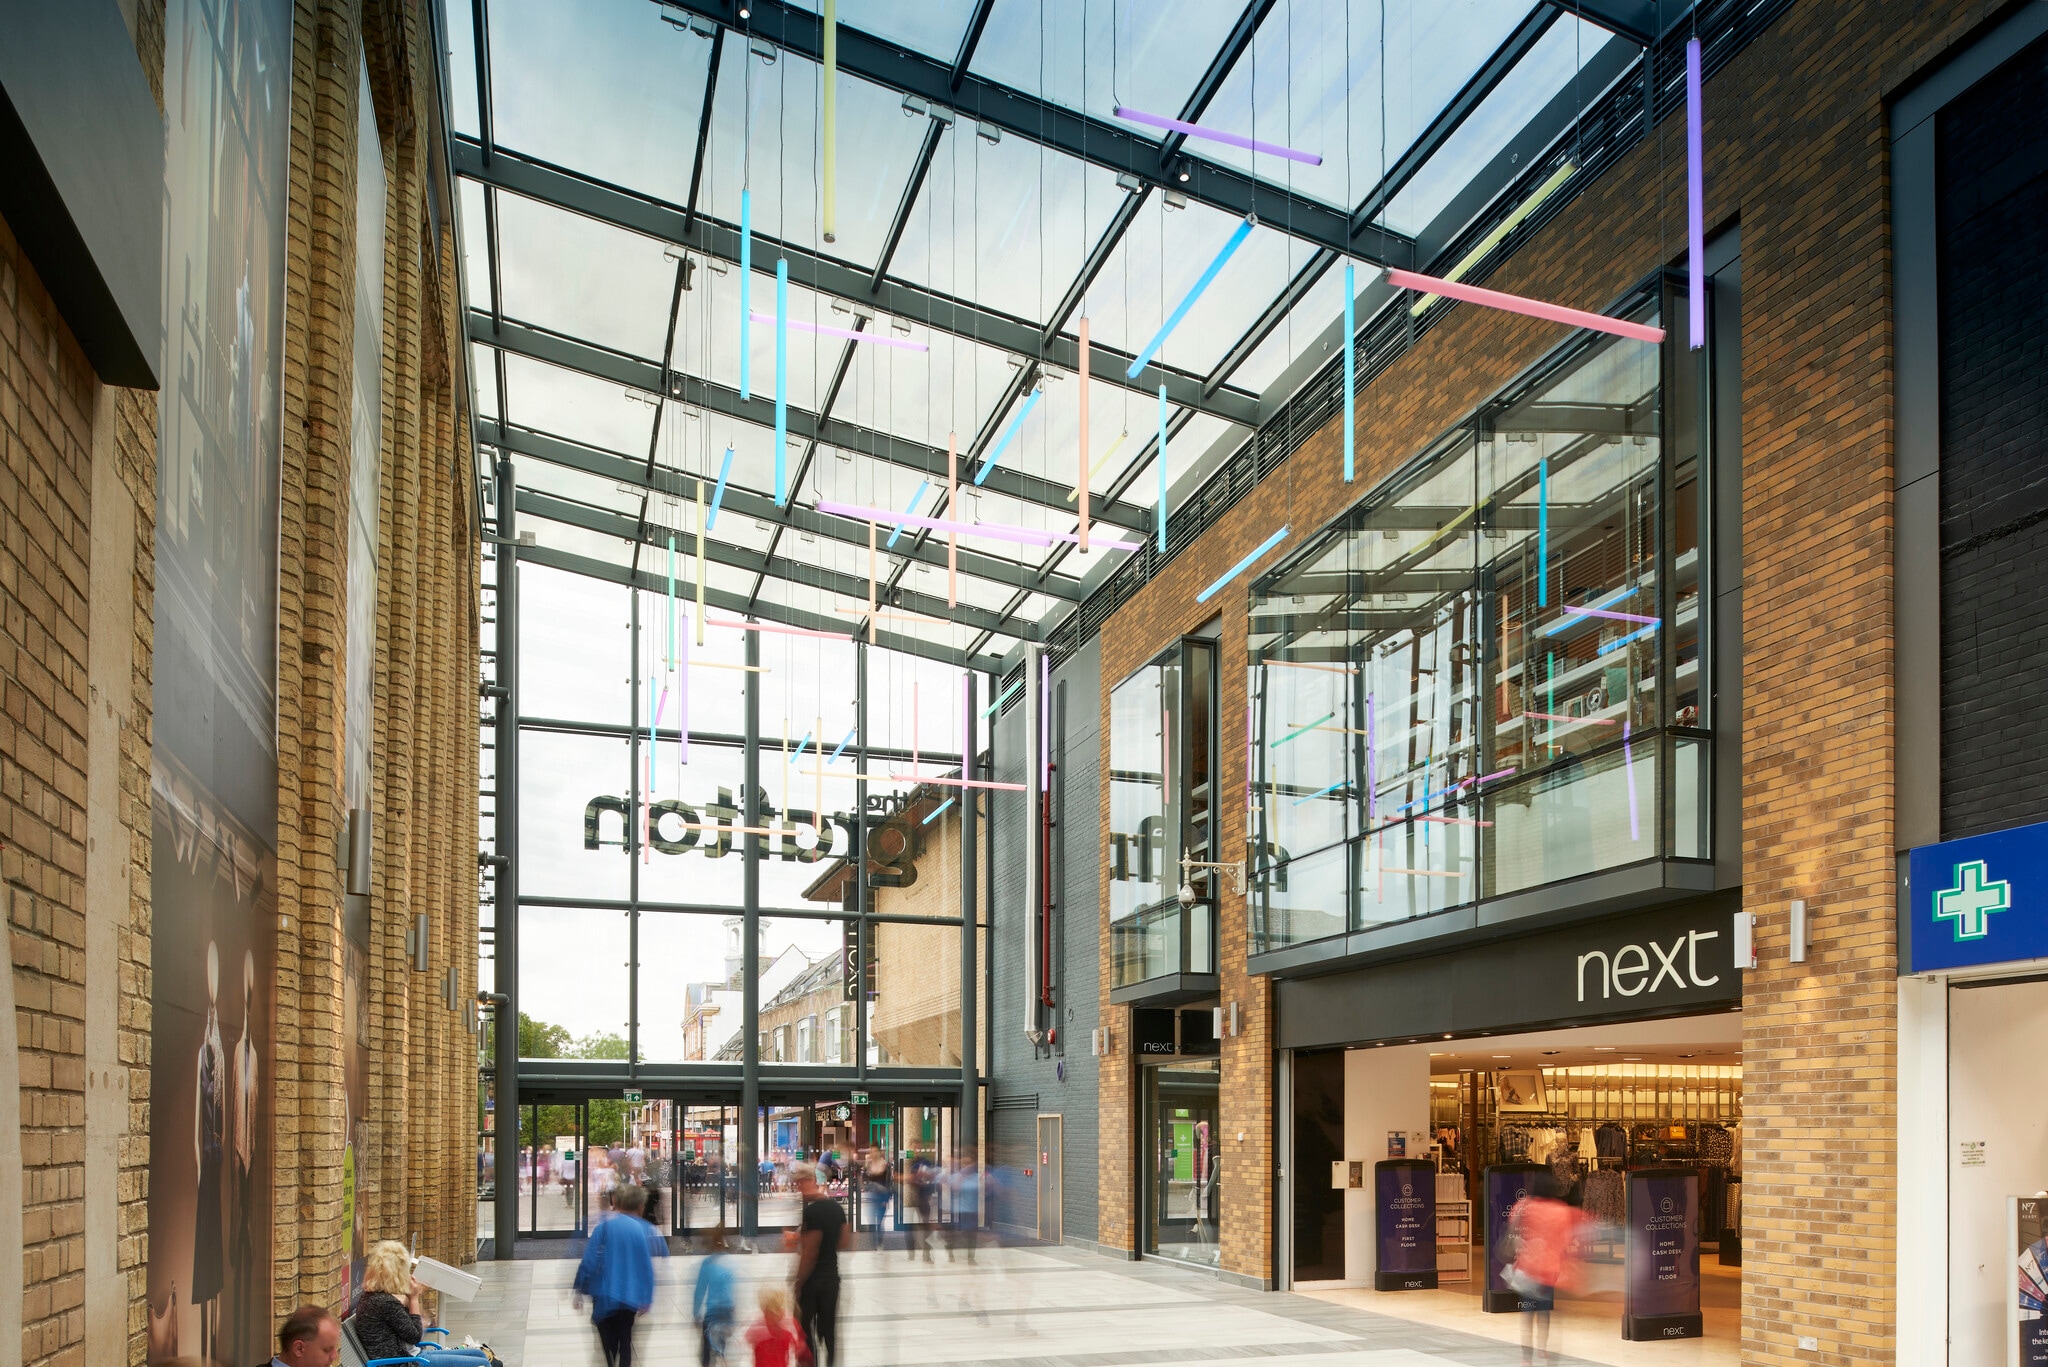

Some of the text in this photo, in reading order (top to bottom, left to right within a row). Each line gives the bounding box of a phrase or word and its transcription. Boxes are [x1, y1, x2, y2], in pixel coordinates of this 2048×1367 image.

[1577, 929, 1720, 1002] next
[1143, 1041, 1173, 1052] next
[1650, 1214, 1683, 1223] CUSTOMER
[1645, 1221, 1688, 1231] COLLECTIONS
[1405, 1280, 1423, 1288] next
[1517, 1300, 1537, 1309] next
[1663, 1326, 1685, 1336] next
